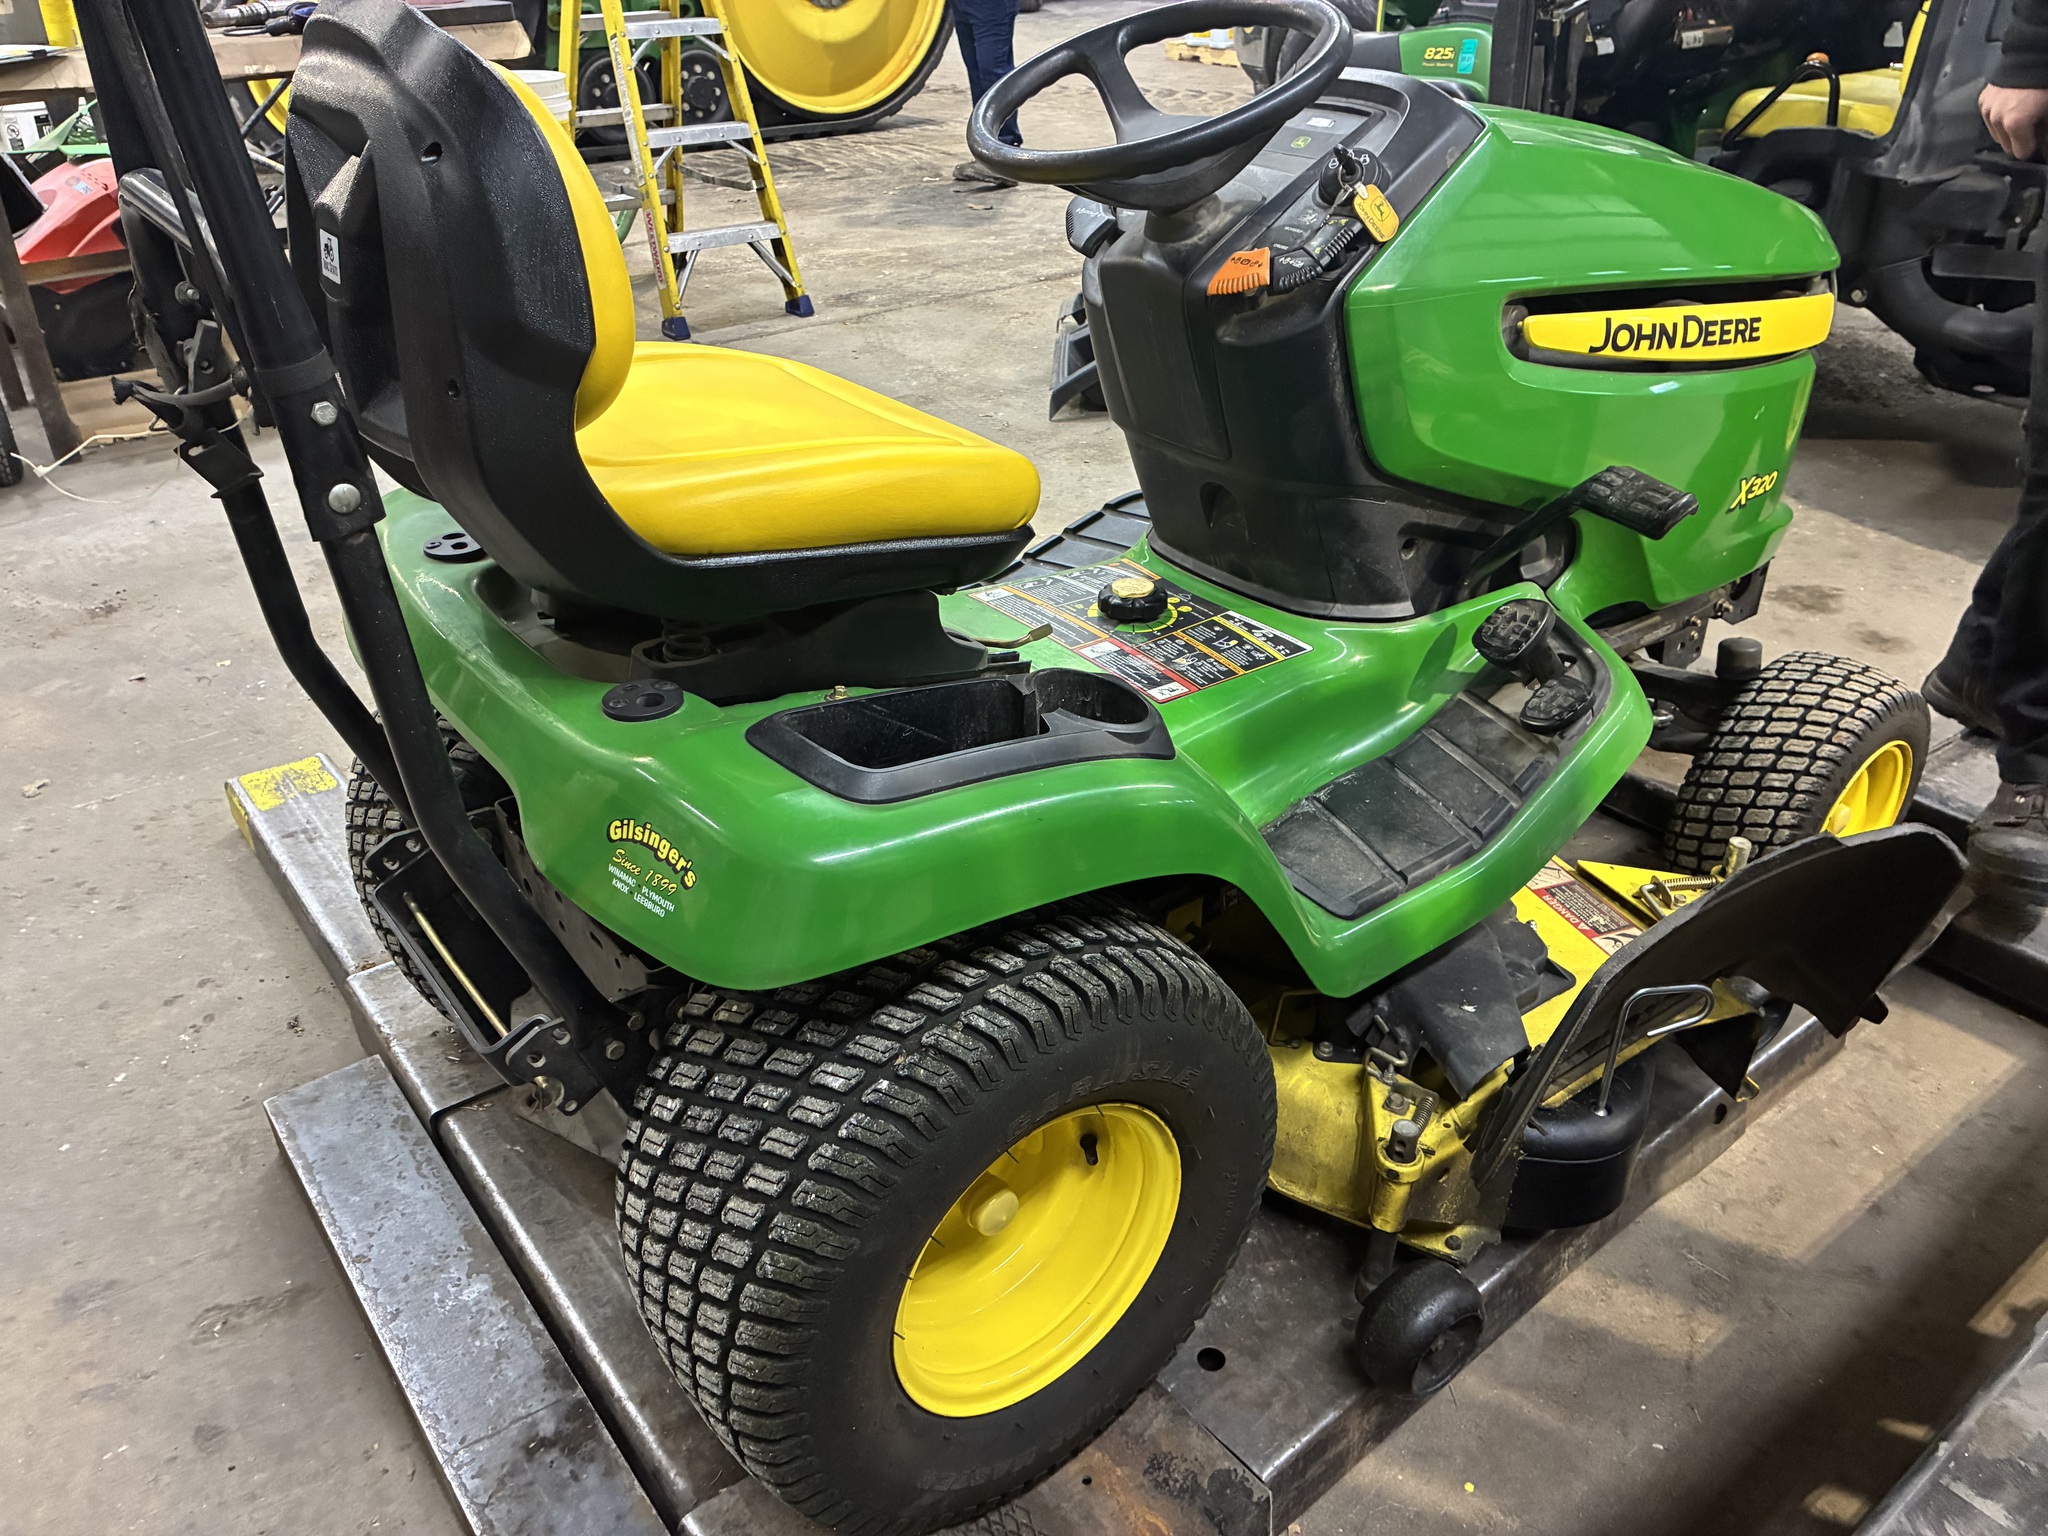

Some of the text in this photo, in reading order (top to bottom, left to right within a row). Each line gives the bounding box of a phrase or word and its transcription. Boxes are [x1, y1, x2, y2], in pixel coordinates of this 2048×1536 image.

[1424, 47, 1455, 60] 825i
[1356, 201, 1386, 240] JOHN DEERE
[646, 211, 663, 284] WESTWARD
[1588, 314, 1762, 353] JOHN DEERE
[1726, 469, 1779, 512] X320
[607, 818, 697, 890] Gilsinger's
[612, 849, 678, 896] Since 1899
[608, 863, 676, 913] WINAMAC PLYMOUTH
[612, 877, 630, 895] KNOX
[1541, 894, 1580, 924] DANGER
